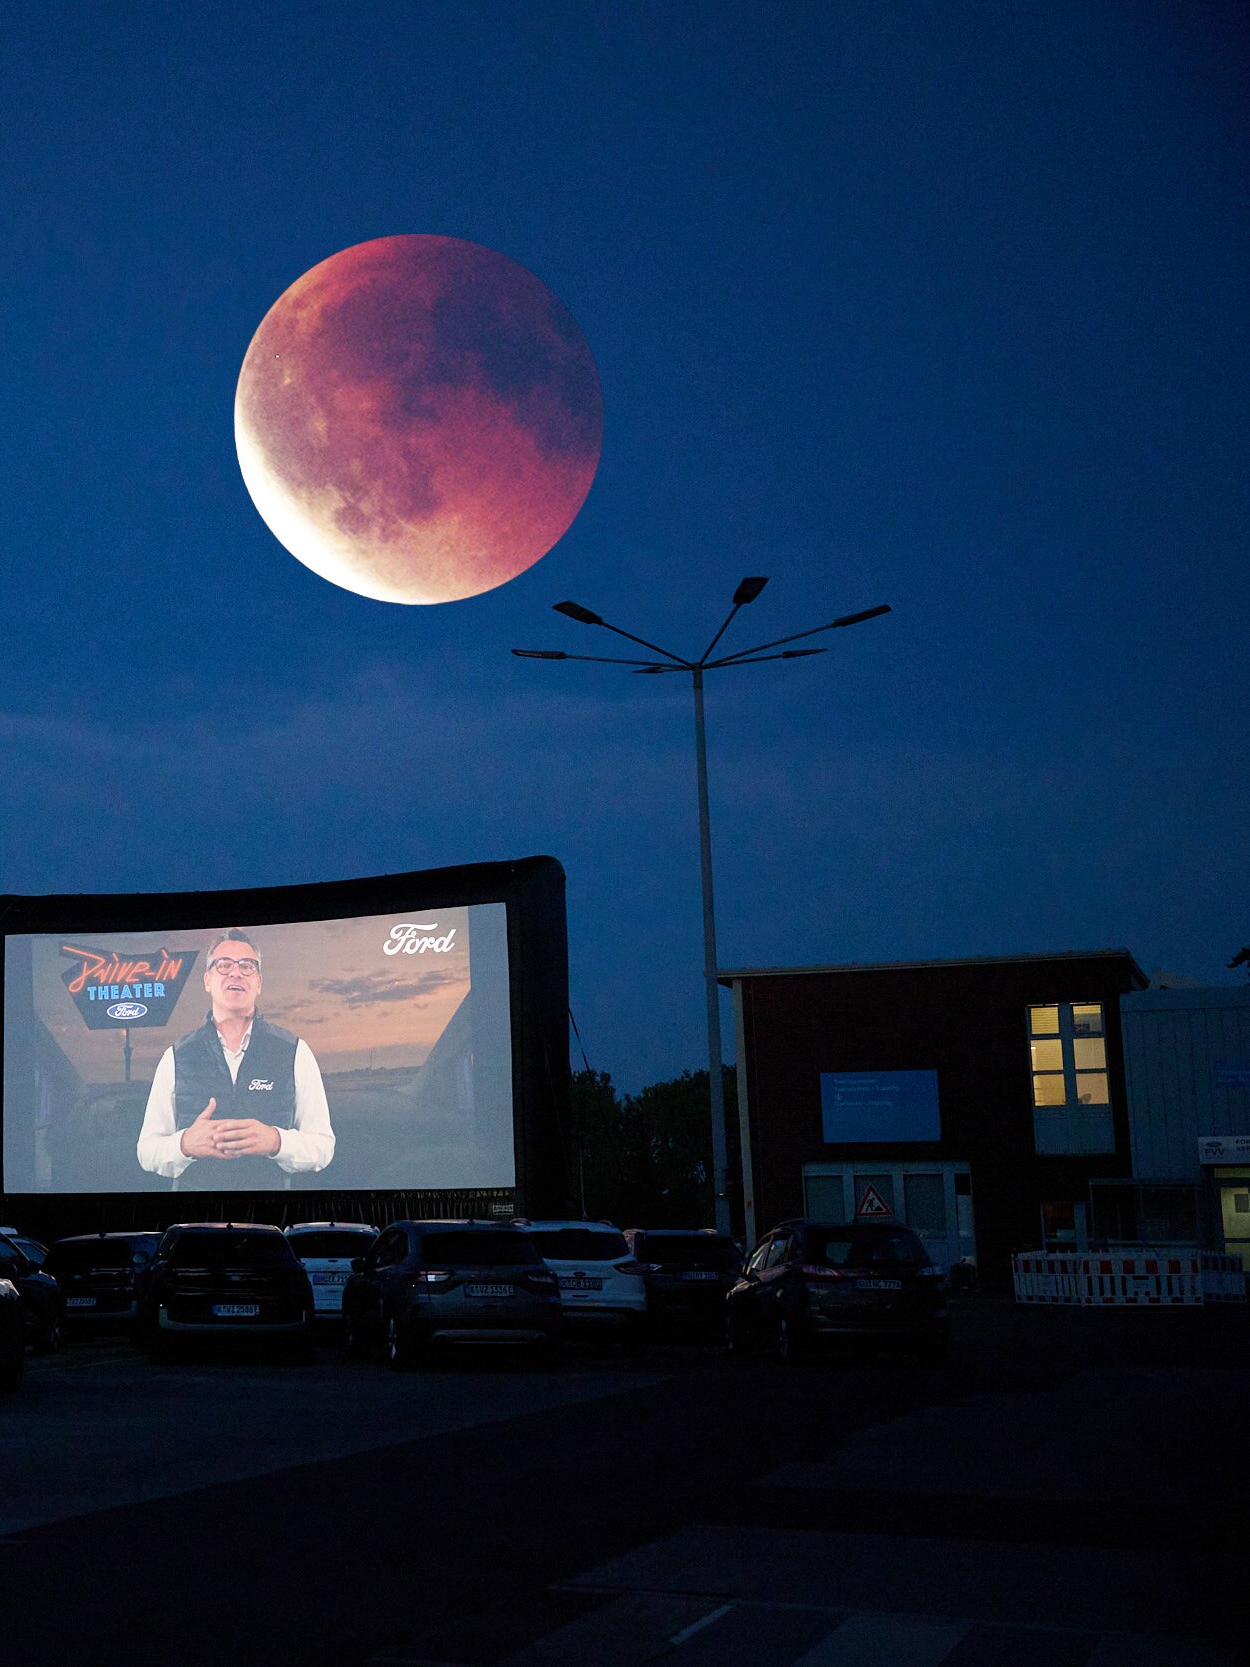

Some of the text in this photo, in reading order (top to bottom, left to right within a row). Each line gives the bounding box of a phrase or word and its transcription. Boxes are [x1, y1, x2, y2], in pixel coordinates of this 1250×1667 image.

[383, 923, 457, 956] Ford
[87, 982, 165, 1001] THEATER
[115, 1004, 139, 1017] Ford
[248, 1079, 274, 1091] Ford
